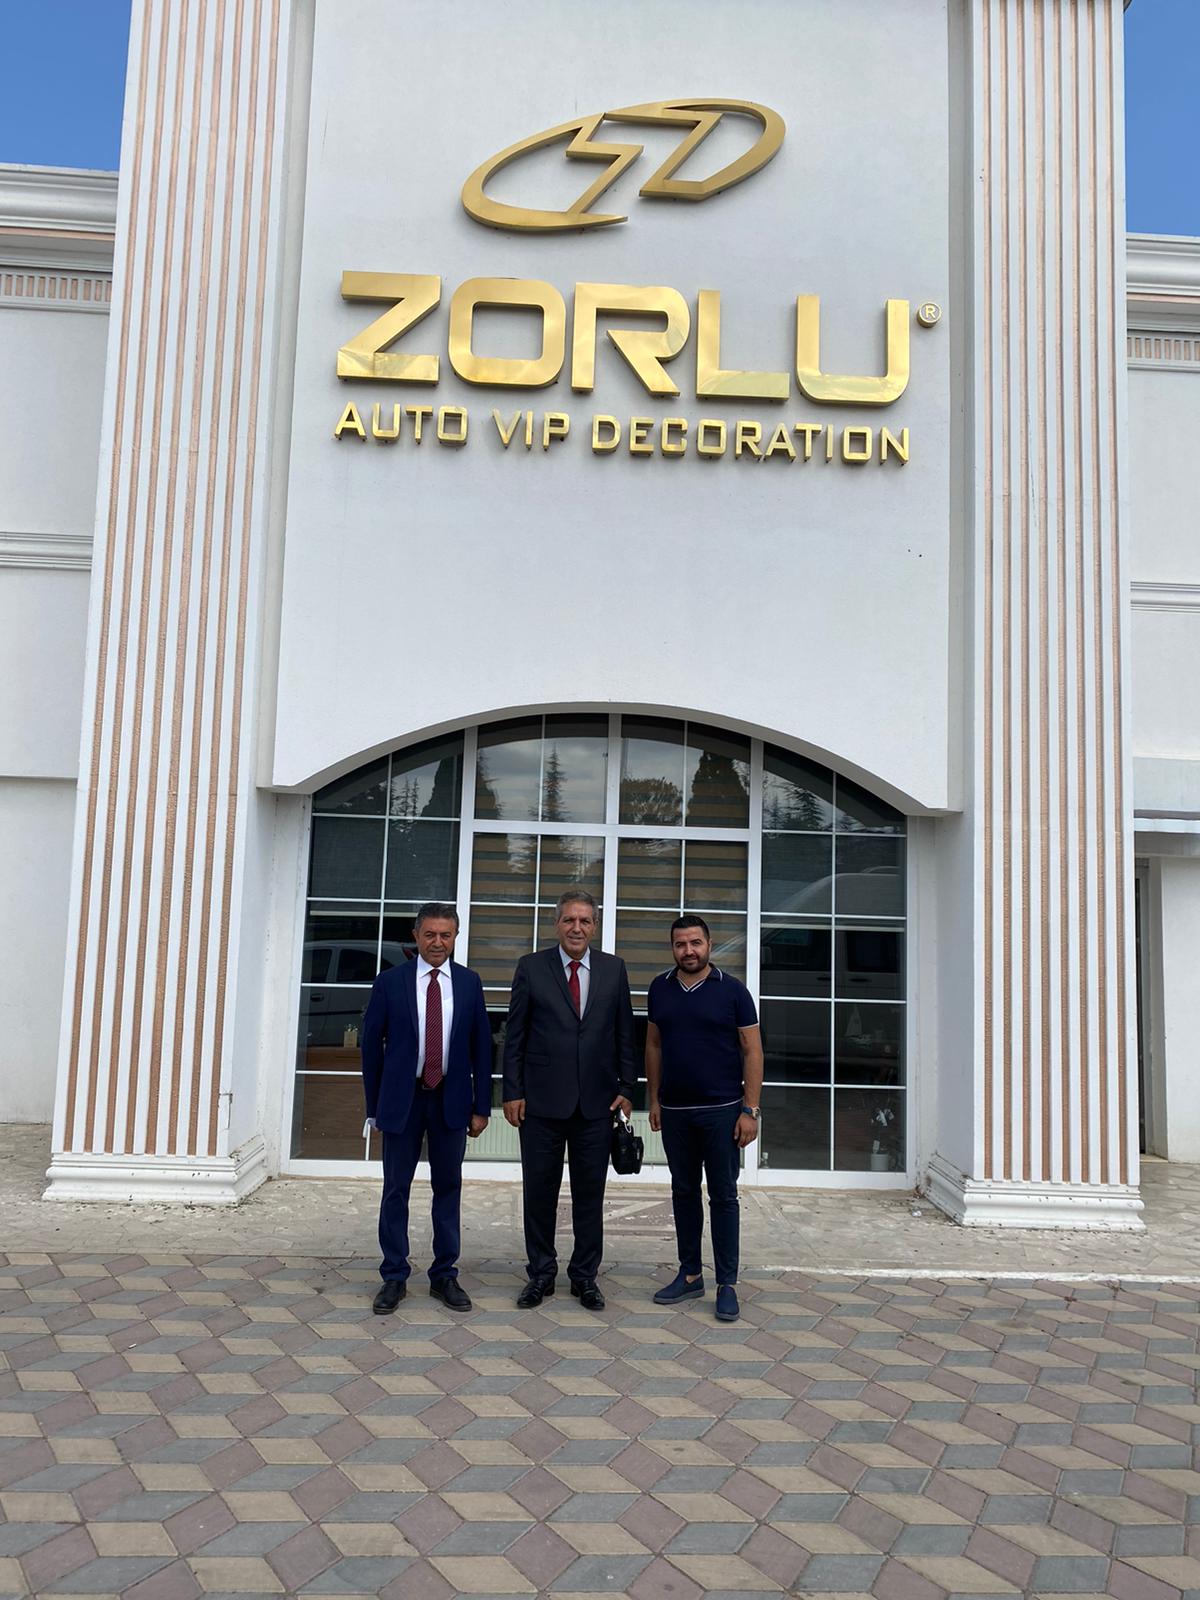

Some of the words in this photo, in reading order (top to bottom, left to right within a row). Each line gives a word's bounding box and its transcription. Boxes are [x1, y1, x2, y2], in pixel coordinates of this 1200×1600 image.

[337, 270, 910, 404] ZORLU
[335, 402, 468, 444] AUTO
[492, 408, 570, 449] VIP
[592, 414, 910, 463] DECORATION
